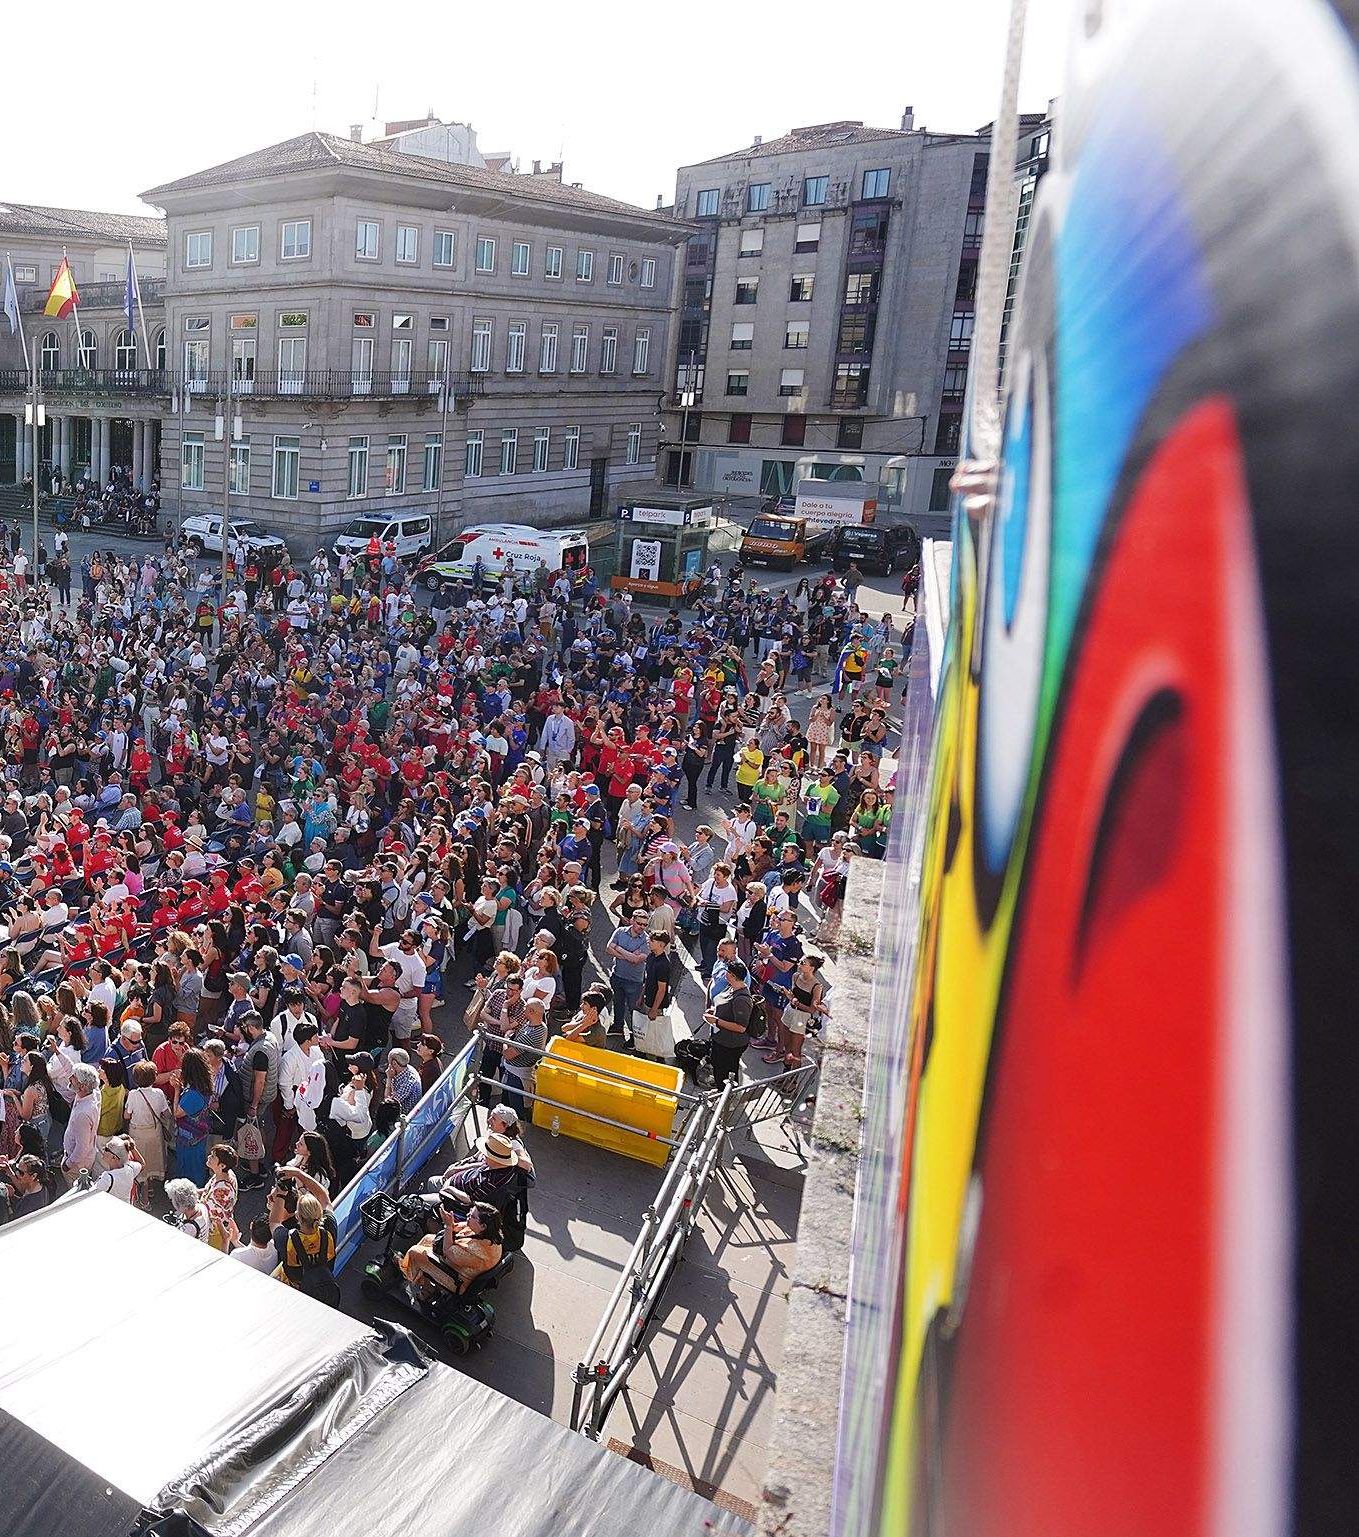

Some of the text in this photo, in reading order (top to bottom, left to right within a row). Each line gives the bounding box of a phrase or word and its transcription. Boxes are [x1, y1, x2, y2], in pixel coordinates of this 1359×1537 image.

[801, 509, 826, 517] cuerpo
[505, 551, 541, 563] Cruz Roja
